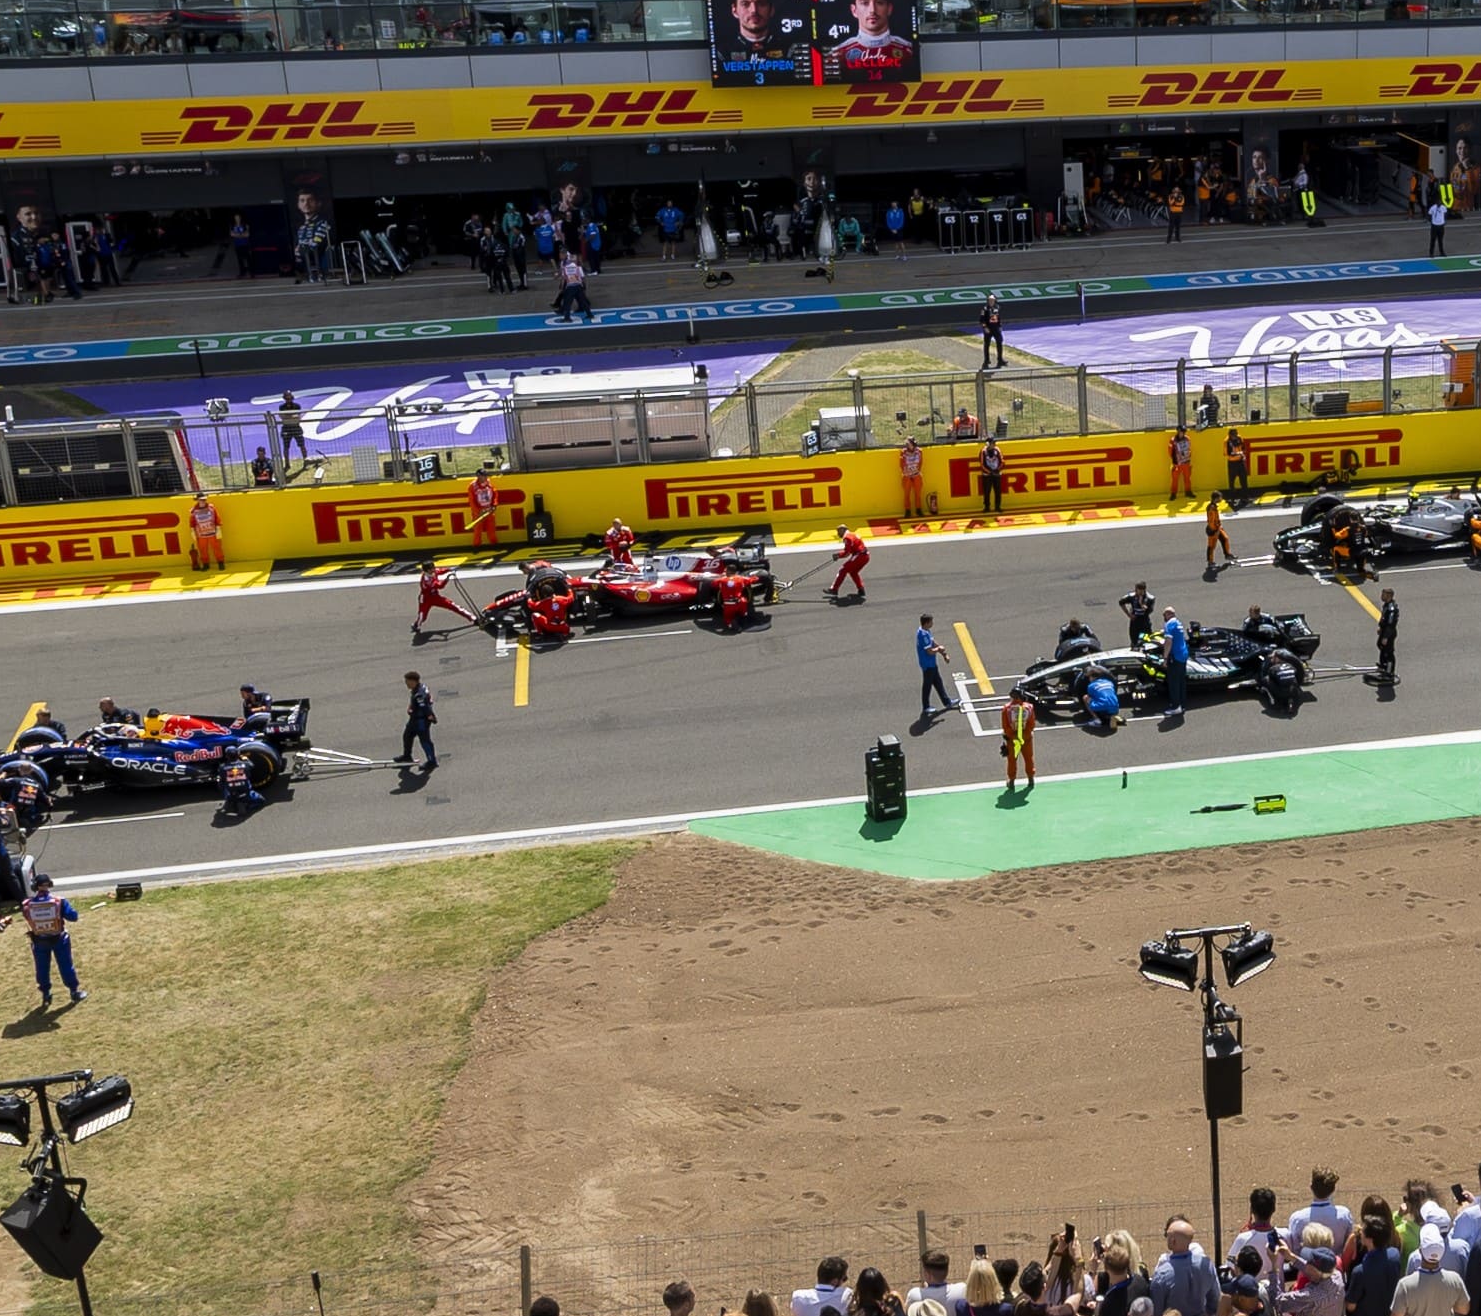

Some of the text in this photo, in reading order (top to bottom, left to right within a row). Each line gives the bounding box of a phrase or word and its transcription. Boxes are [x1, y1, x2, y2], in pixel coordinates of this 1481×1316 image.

[781, 18, 802, 33] 3RD
[828, 23, 850, 39] 4TH
[723, 60, 795, 72] VERSTAPPEN
[847, 56, 901, 68] LECLERC
[755, 72, 765, 84] 3
[1139, 69, 1295, 106] DHL
[843, 80, 1014, 118] DHL
[526, 89, 710, 130] DHL
[180, 101, 379, 144] DHL
[1187, 262, 1401, 285] aramco
[880, 281, 1112, 305] aramco
[544, 298, 794, 326] aramco
[1304, 308, 1377, 328] LAS
[177, 322, 452, 350] aramco
[1130, 313, 1458, 372] Vegas
[418, 458, 433, 471] 16
[949, 447, 1133, 498] PRELLI
[420, 471, 435, 482] LEC
[645, 467, 842, 520] PIRELLI
[533, 528, 547, 539] 16
[667, 557, 680, 571] hp
[703, 559, 721, 569] 16
[266, 726, 290, 734] Mobil
[174, 746, 223, 763] Red Bull
[111, 757, 187, 776] ORACLE
